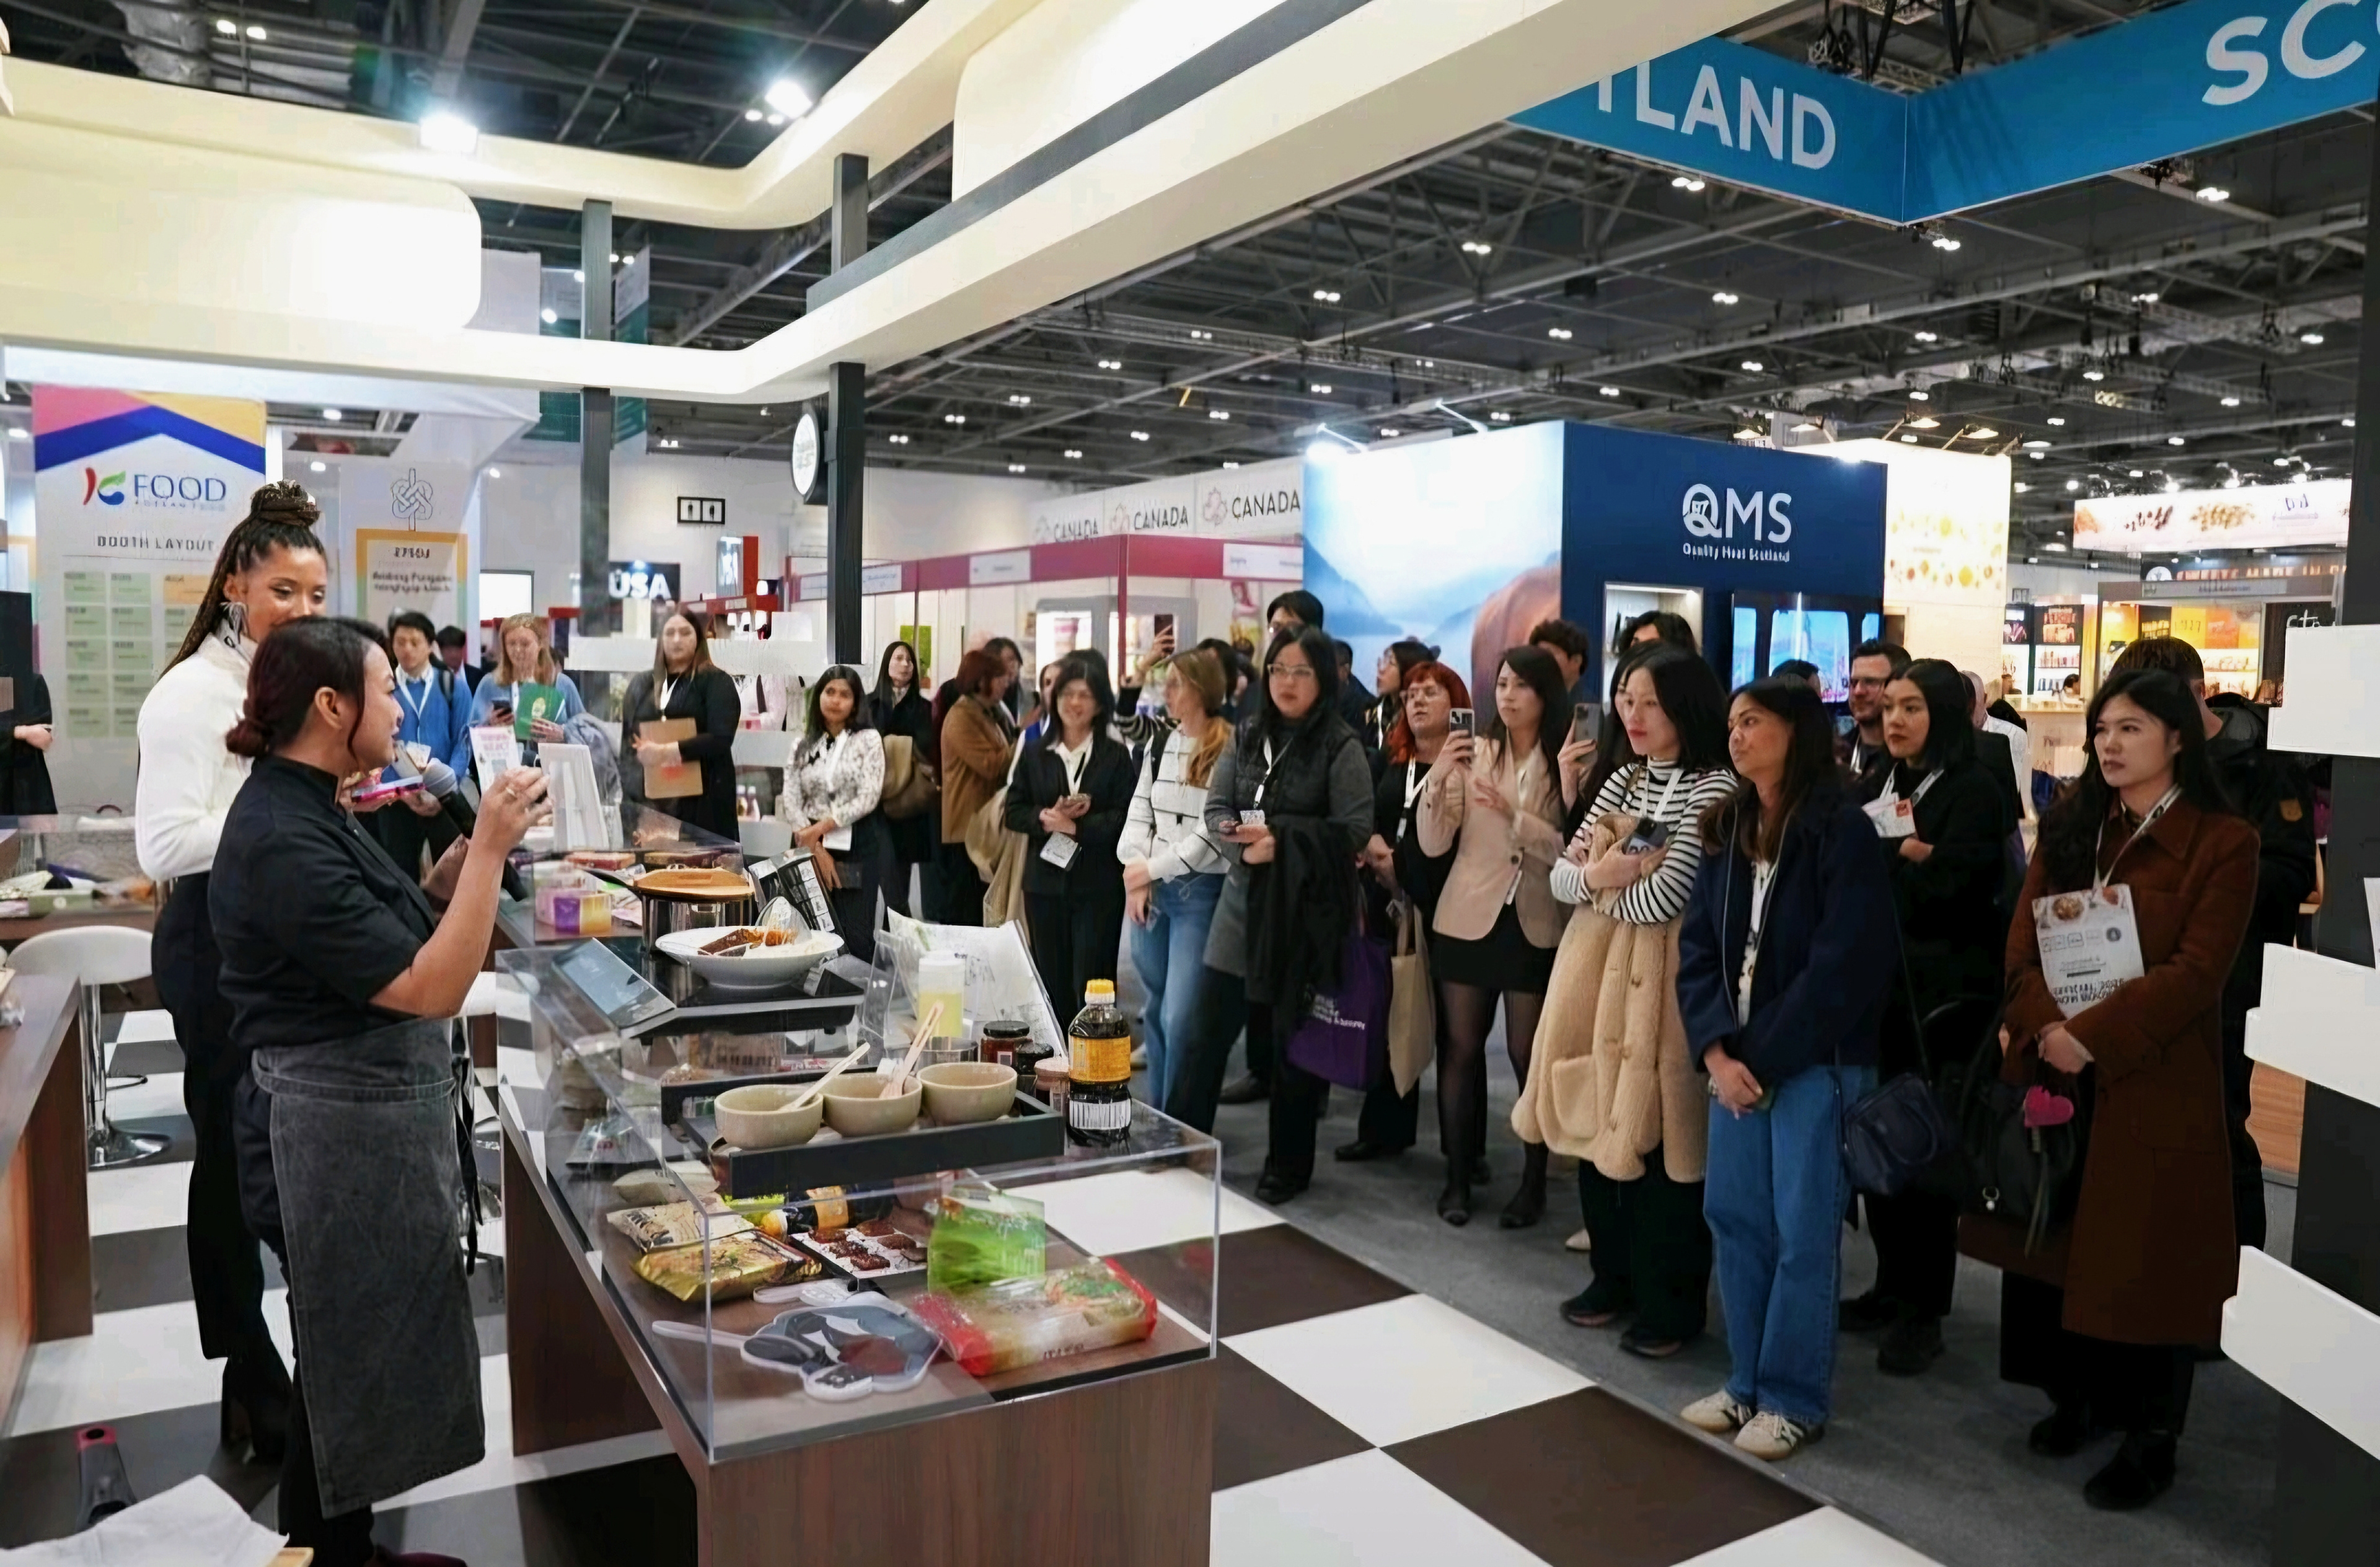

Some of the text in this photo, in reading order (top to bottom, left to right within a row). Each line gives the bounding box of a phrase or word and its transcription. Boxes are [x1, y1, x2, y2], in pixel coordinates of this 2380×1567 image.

[2202, 0, 2380, 105] SC
[134, 474, 227, 501] FOOD
[1134, 506, 1189, 530] CANADA
[1232, 490, 1300, 522] CANADA
[1682, 483, 1792, 543] QMS
[1054, 519, 1098, 542] CANADA
[609, 570, 672, 600] USA
